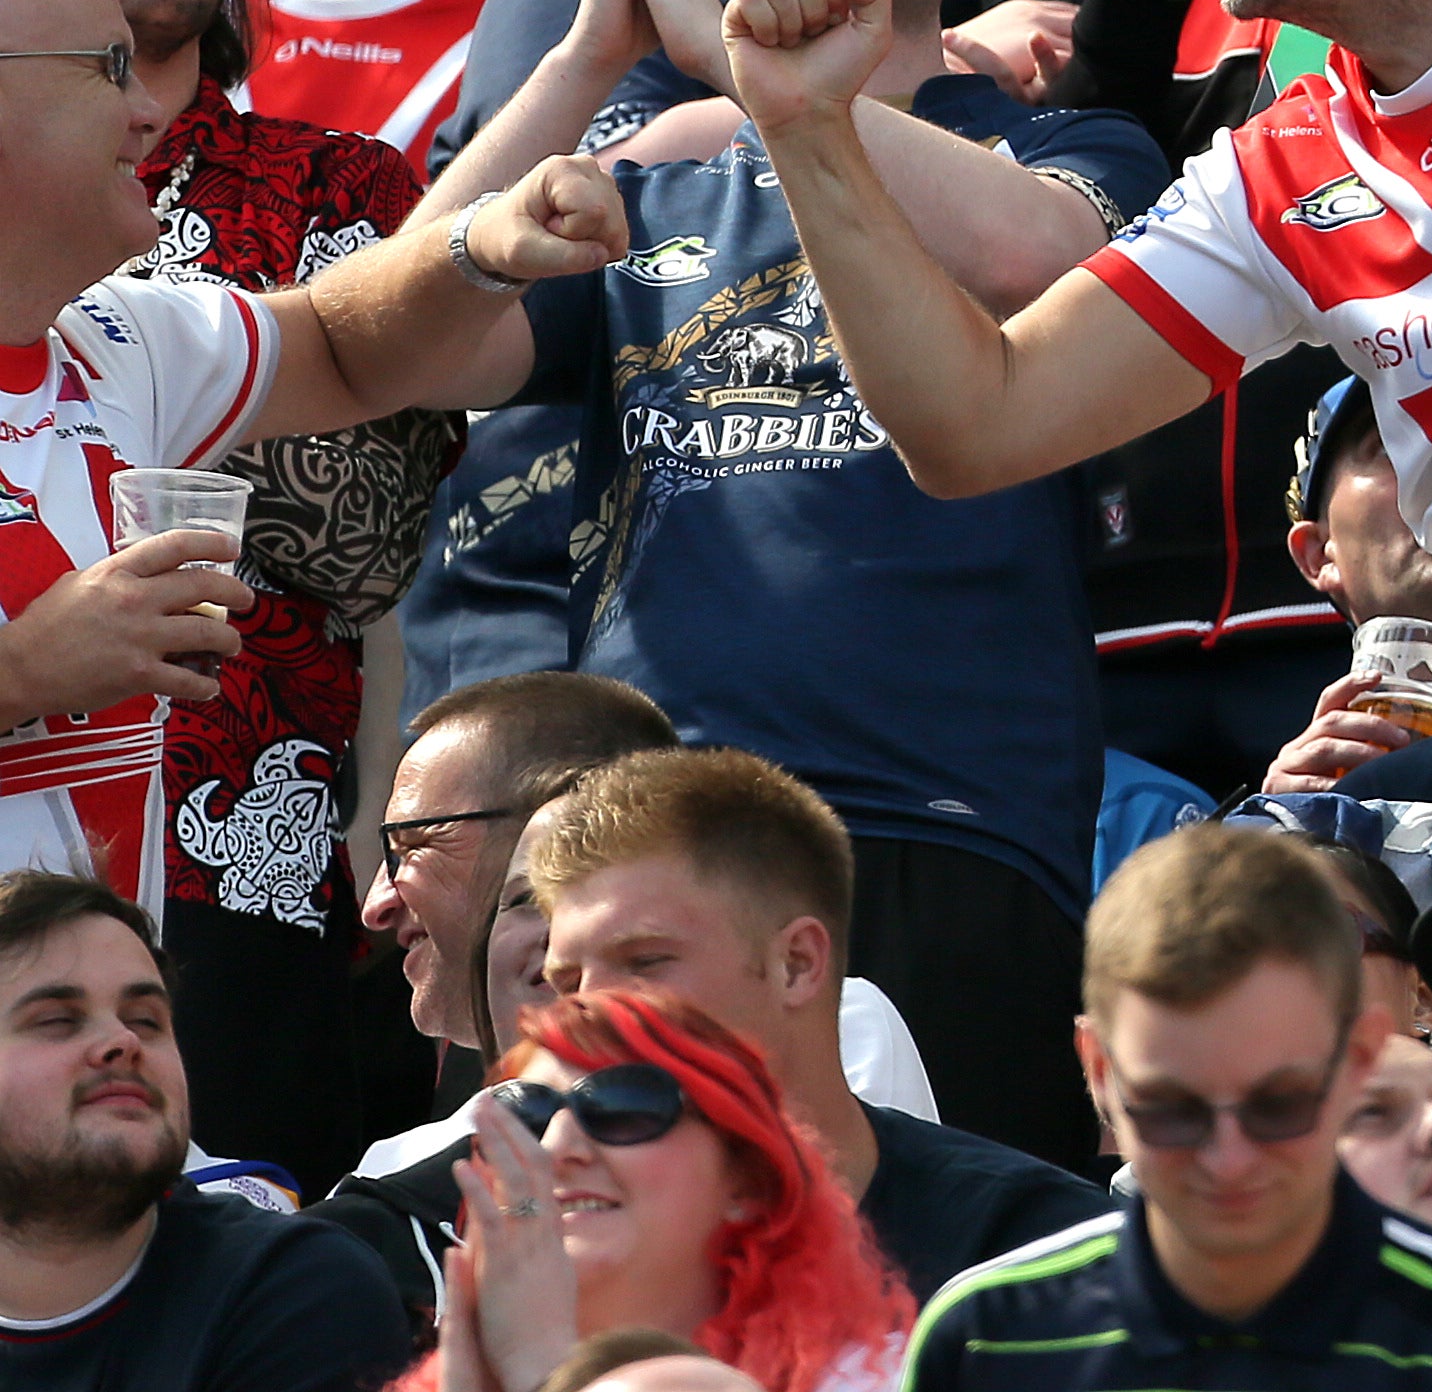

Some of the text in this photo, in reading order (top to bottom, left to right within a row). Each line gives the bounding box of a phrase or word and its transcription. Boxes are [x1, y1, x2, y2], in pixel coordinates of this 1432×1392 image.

[715, 390, 775, 404] EDINBURGH
[641, 456, 843, 479] ALCOHOLIC GINGER BEER
